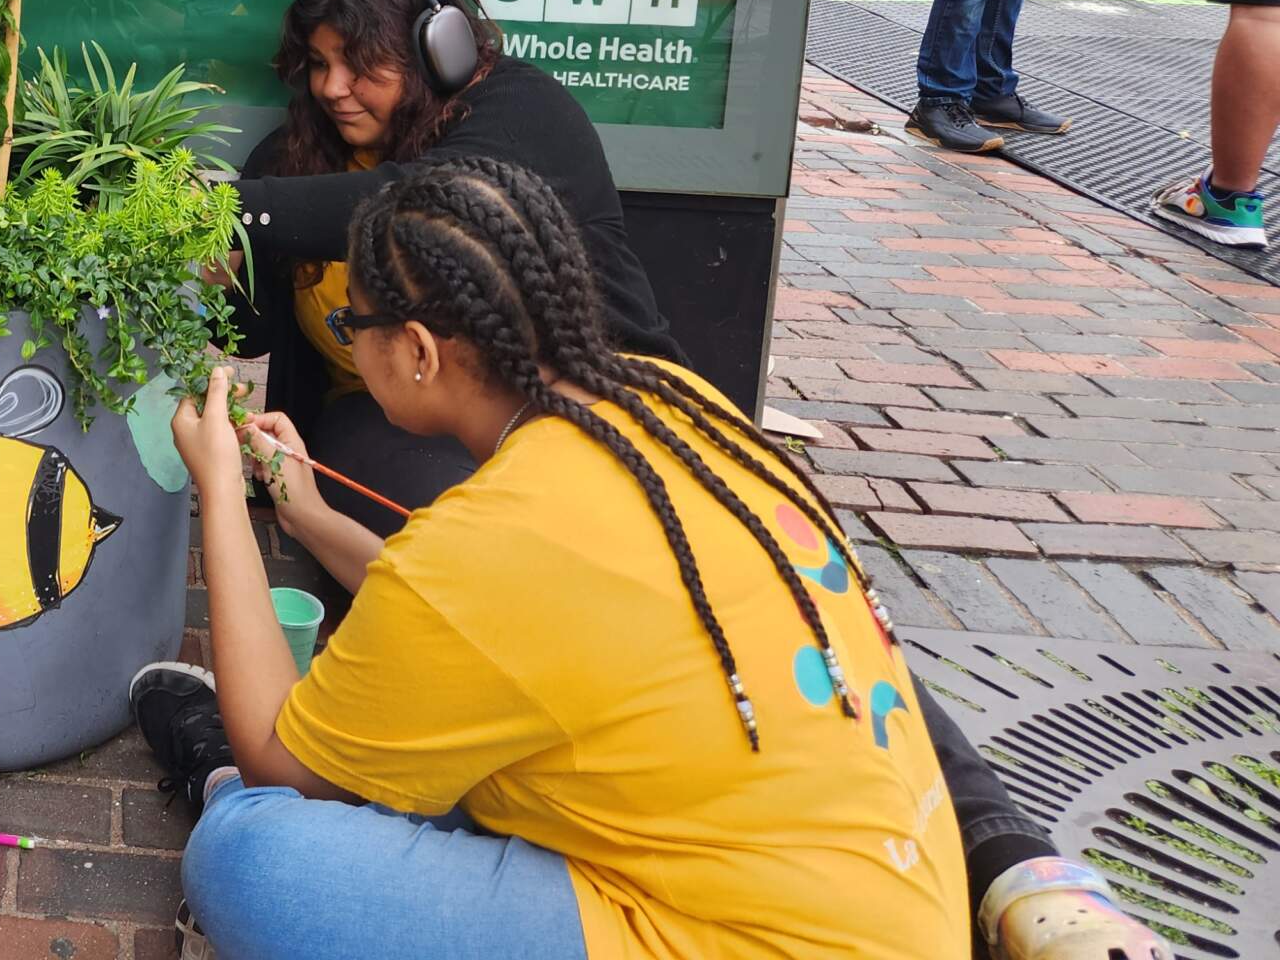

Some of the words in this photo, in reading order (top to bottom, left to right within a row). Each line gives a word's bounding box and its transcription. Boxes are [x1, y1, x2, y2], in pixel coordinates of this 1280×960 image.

[502, 33, 593, 61] Whole
[599, 36, 694, 64] Health
[552, 70, 691, 92] HEALTHCARE
